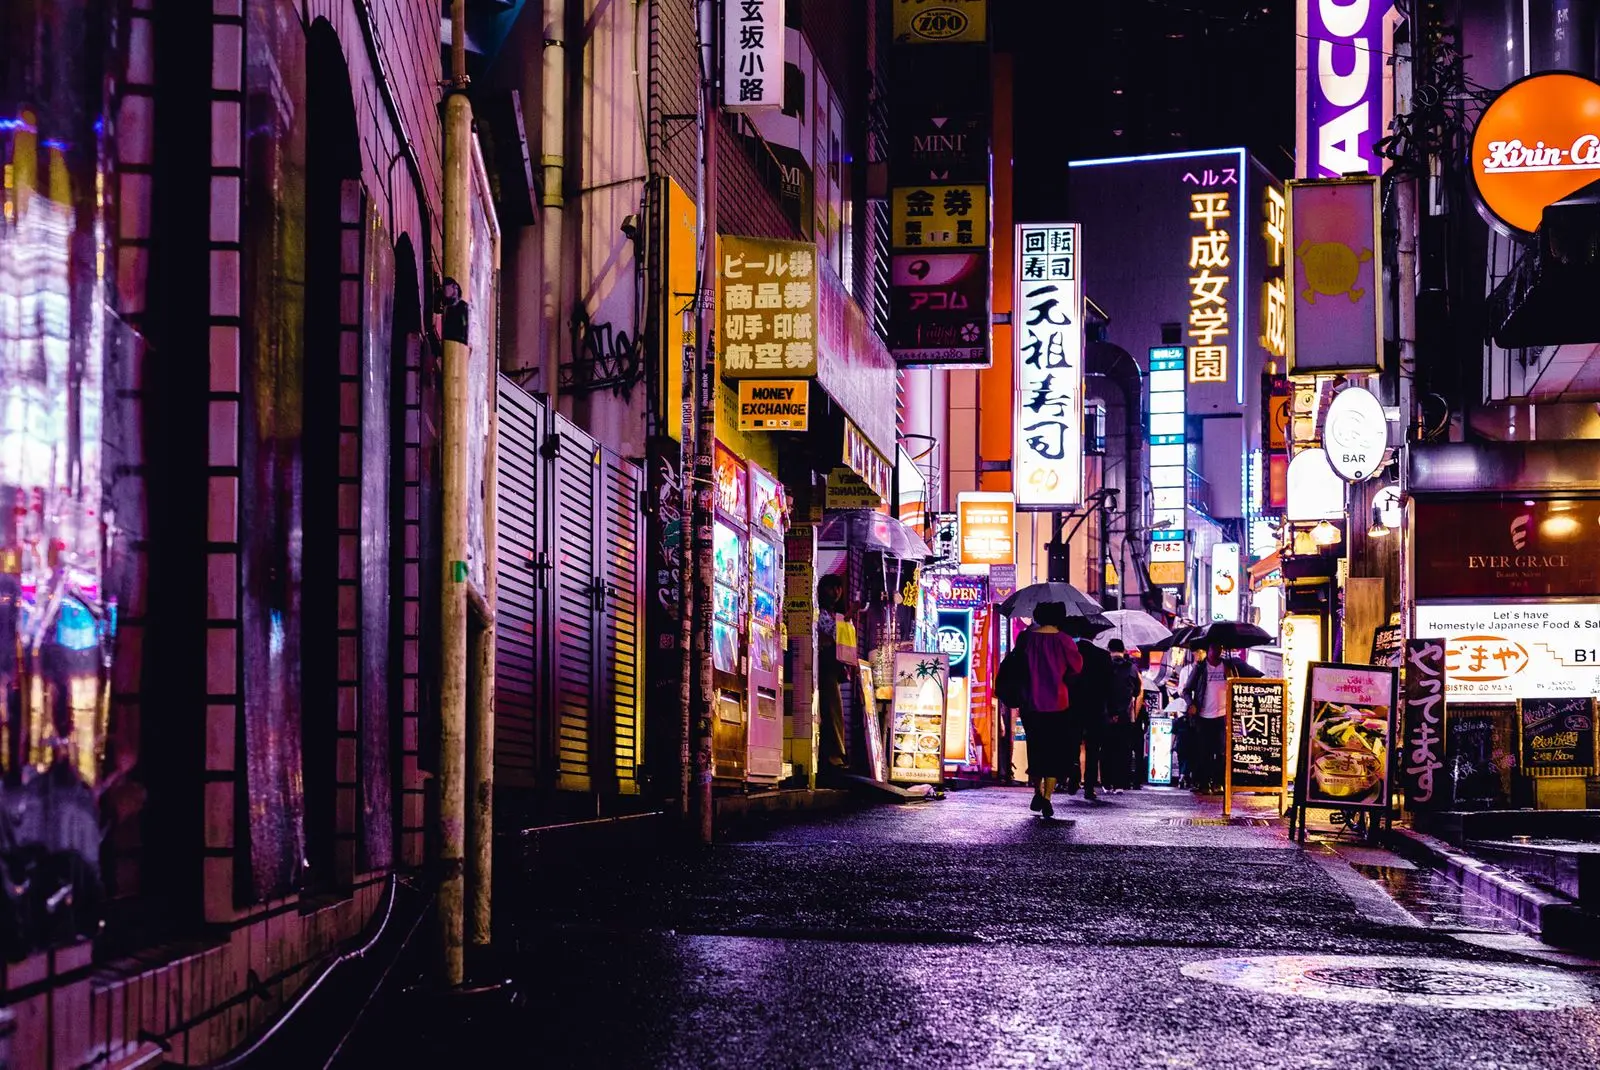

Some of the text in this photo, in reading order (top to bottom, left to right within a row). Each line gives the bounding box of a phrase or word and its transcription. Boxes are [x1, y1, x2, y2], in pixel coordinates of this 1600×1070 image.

[919, 15, 962, 31] ZOO
[913, 134, 967, 152] MINT
[1182, 168, 1238, 186] ヘルス
[905, 189, 972, 217] 金券
[1025, 231, 1071, 252] 回転
[724, 250, 814, 279] ビール券
[1025, 257, 1070, 278] 寿司
[725, 281, 813, 311] 商品券
[1188, 191, 1231, 383] 平成女学園
[909, 291, 968, 310] アコム
[725, 342, 814, 370] 航空券
[1020, 284, 1073, 460] 元祖寿司
[752, 387, 794, 400] MONEY
[741, 403, 807, 416] EXCHANGE
[1342, 454, 1366, 463] BAR
[1469, 555, 1569, 568] EVER GRACE
[942, 587, 978, 600] OPEN
[1523, 611, 1549, 619] have
[1429, 621, 1485, 631] Homestyle
[1488, 621, 1539, 631] Japanese
[1543, 620, 1570, 629] Food
[1573, 620, 1581, 629] &
[1445, 645, 1520, 672] ごまや
[1575, 649, 1596, 662] B1
[1258, 695, 1282, 704] WINE
[1240, 706, 1268, 737] 肉
[1407, 642, 1443, 802] やってます
